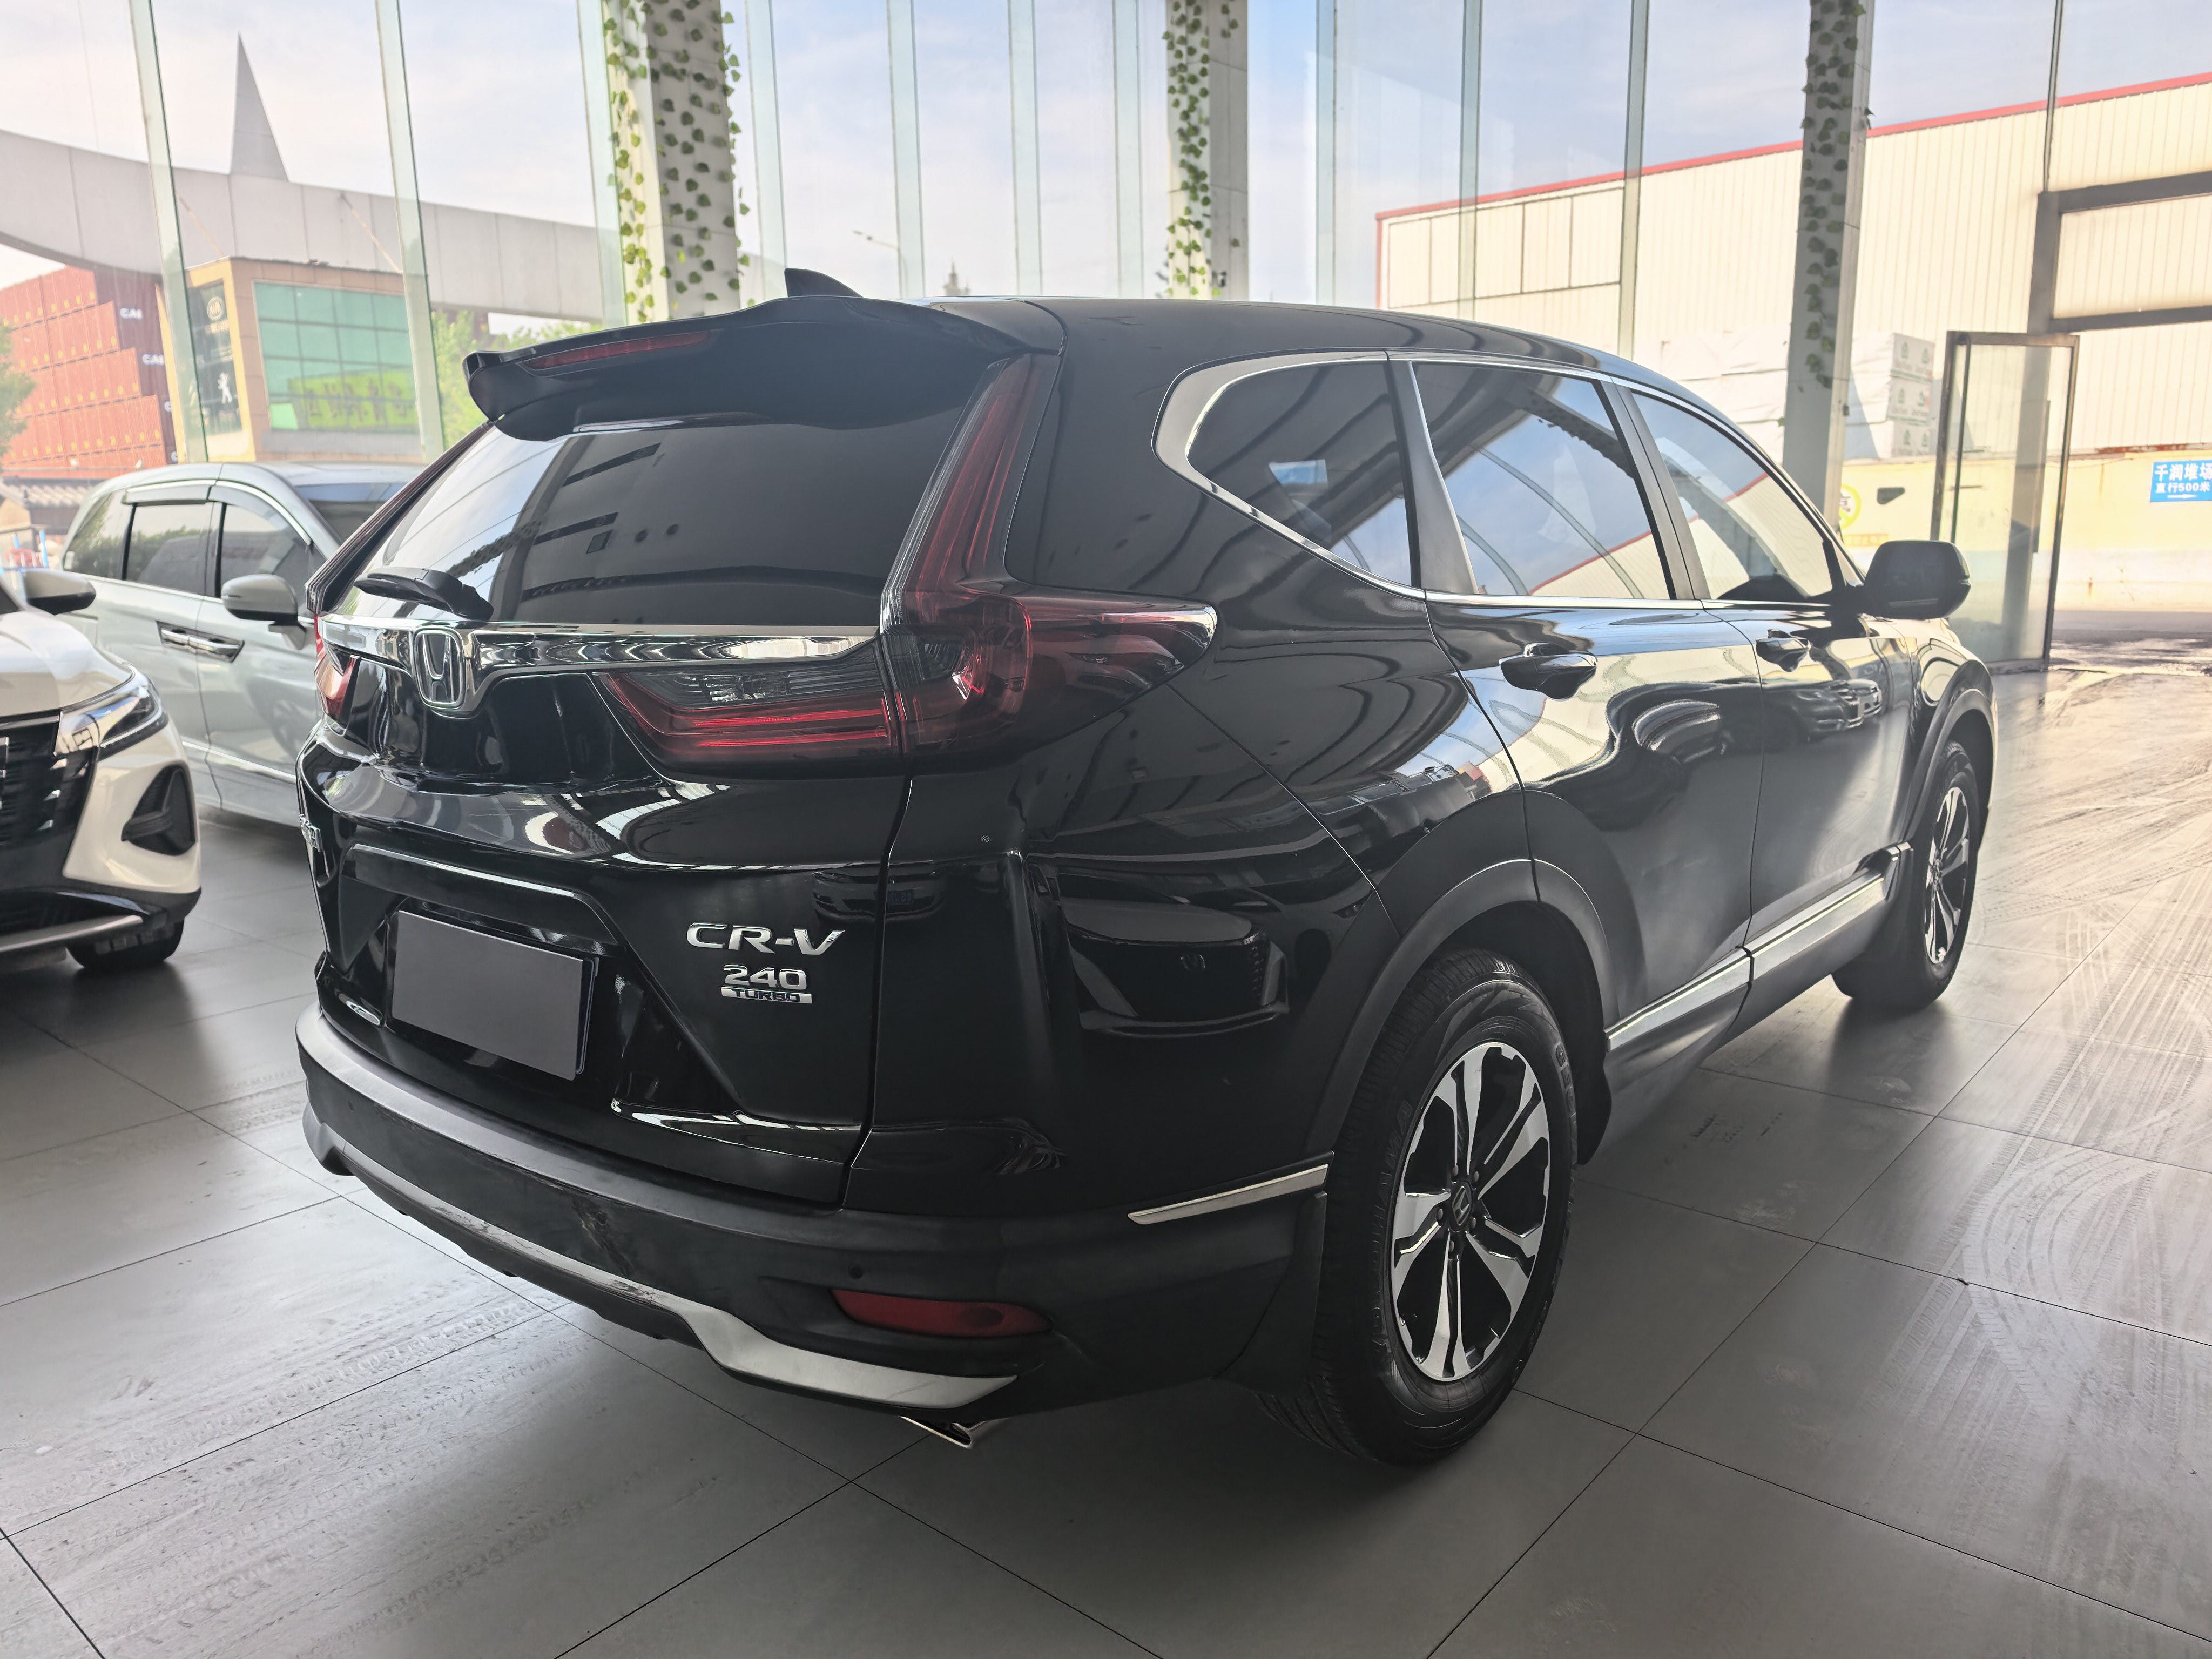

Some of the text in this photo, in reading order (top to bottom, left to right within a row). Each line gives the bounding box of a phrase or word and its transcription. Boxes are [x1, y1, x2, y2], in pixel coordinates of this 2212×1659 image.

[2155, 463, 2212, 481] 千润堆场
[686, 922, 846, 955] CR-V
[723, 964, 807, 990] 240
[729, 988, 801, 1003] TURBO
